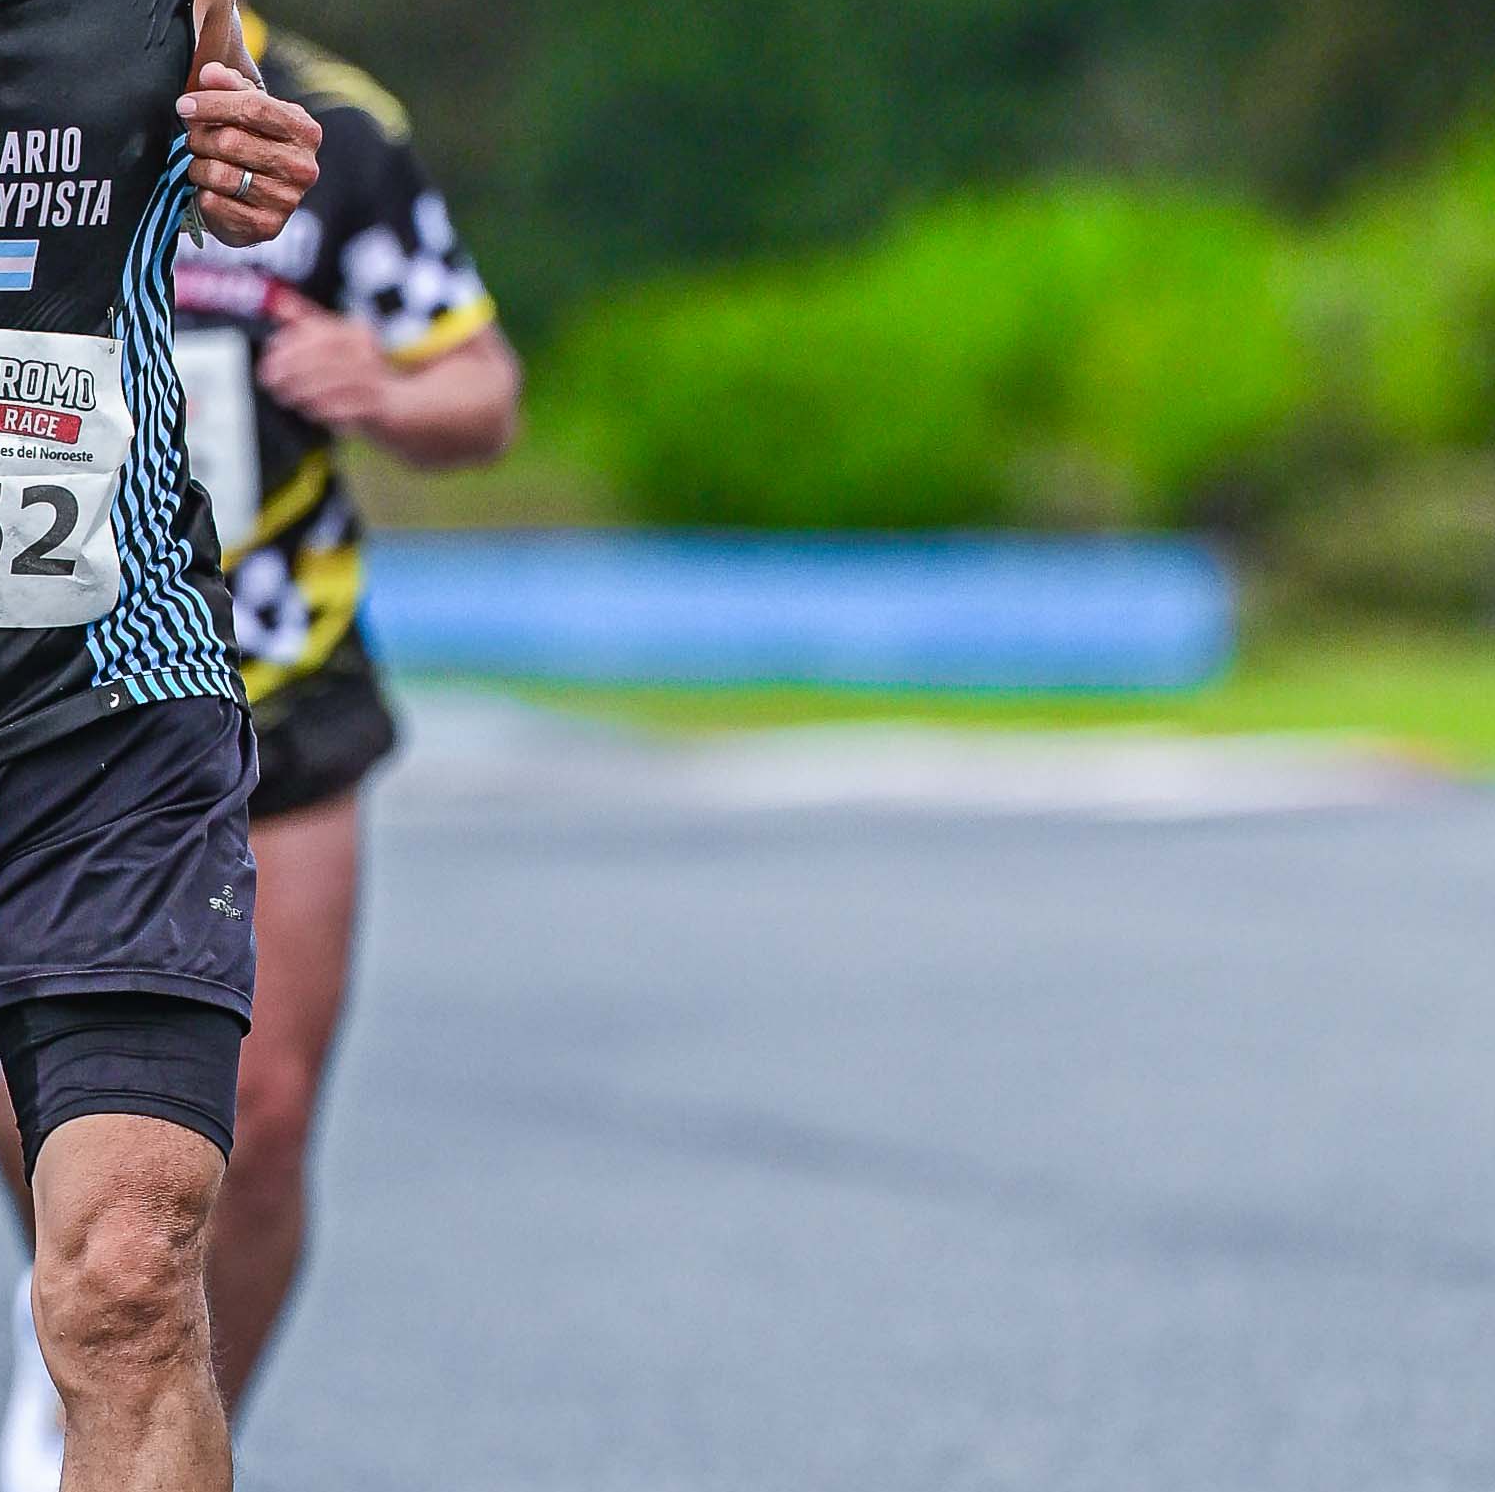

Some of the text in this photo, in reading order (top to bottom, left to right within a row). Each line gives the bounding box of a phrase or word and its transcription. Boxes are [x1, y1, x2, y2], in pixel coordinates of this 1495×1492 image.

[4, 410, 61, 439] RACE
[17, 446, 36, 459] del
[40, 447, 94, 462] Noroeste
